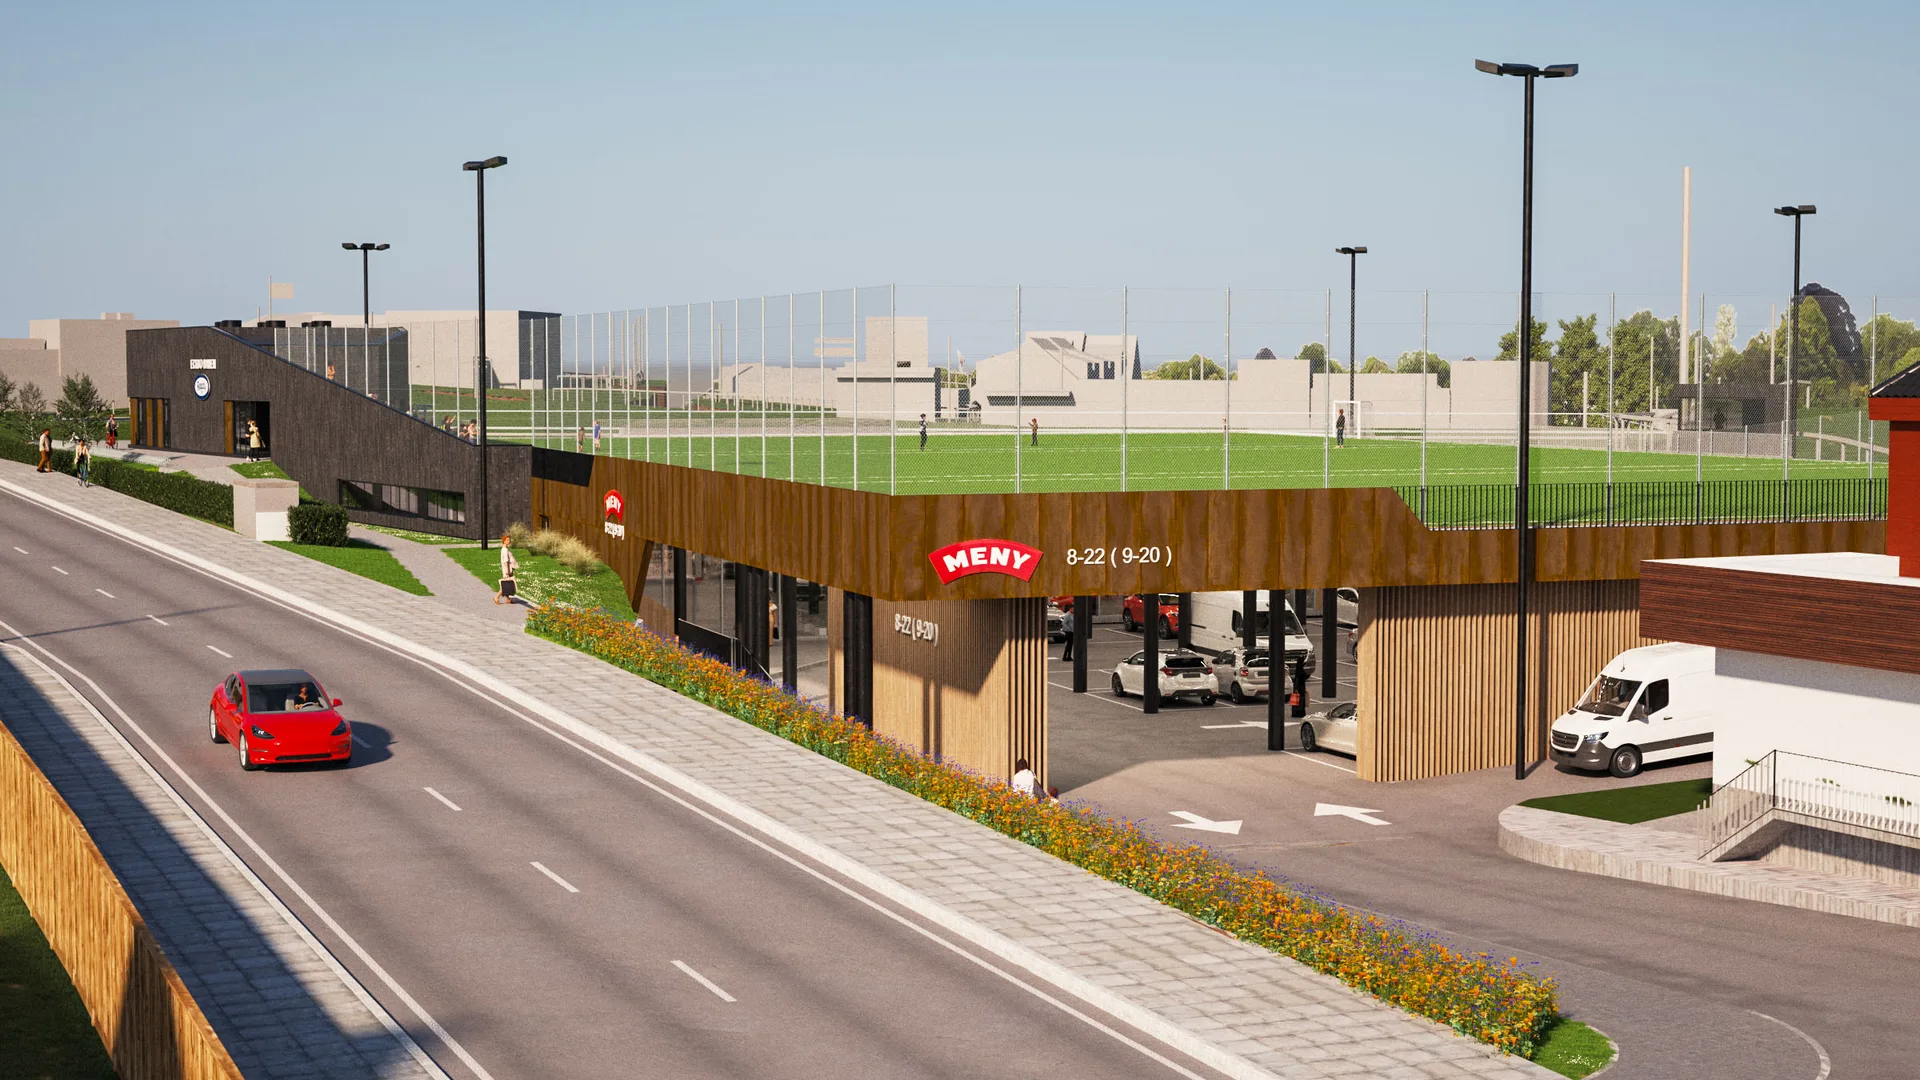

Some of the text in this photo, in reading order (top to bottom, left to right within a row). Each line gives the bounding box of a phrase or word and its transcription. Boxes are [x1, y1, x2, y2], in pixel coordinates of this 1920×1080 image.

[942, 546, 1031, 573] MENY
[1066, 548, 1106, 566] 8-22
[895, 613, 912, 635] 8-22
